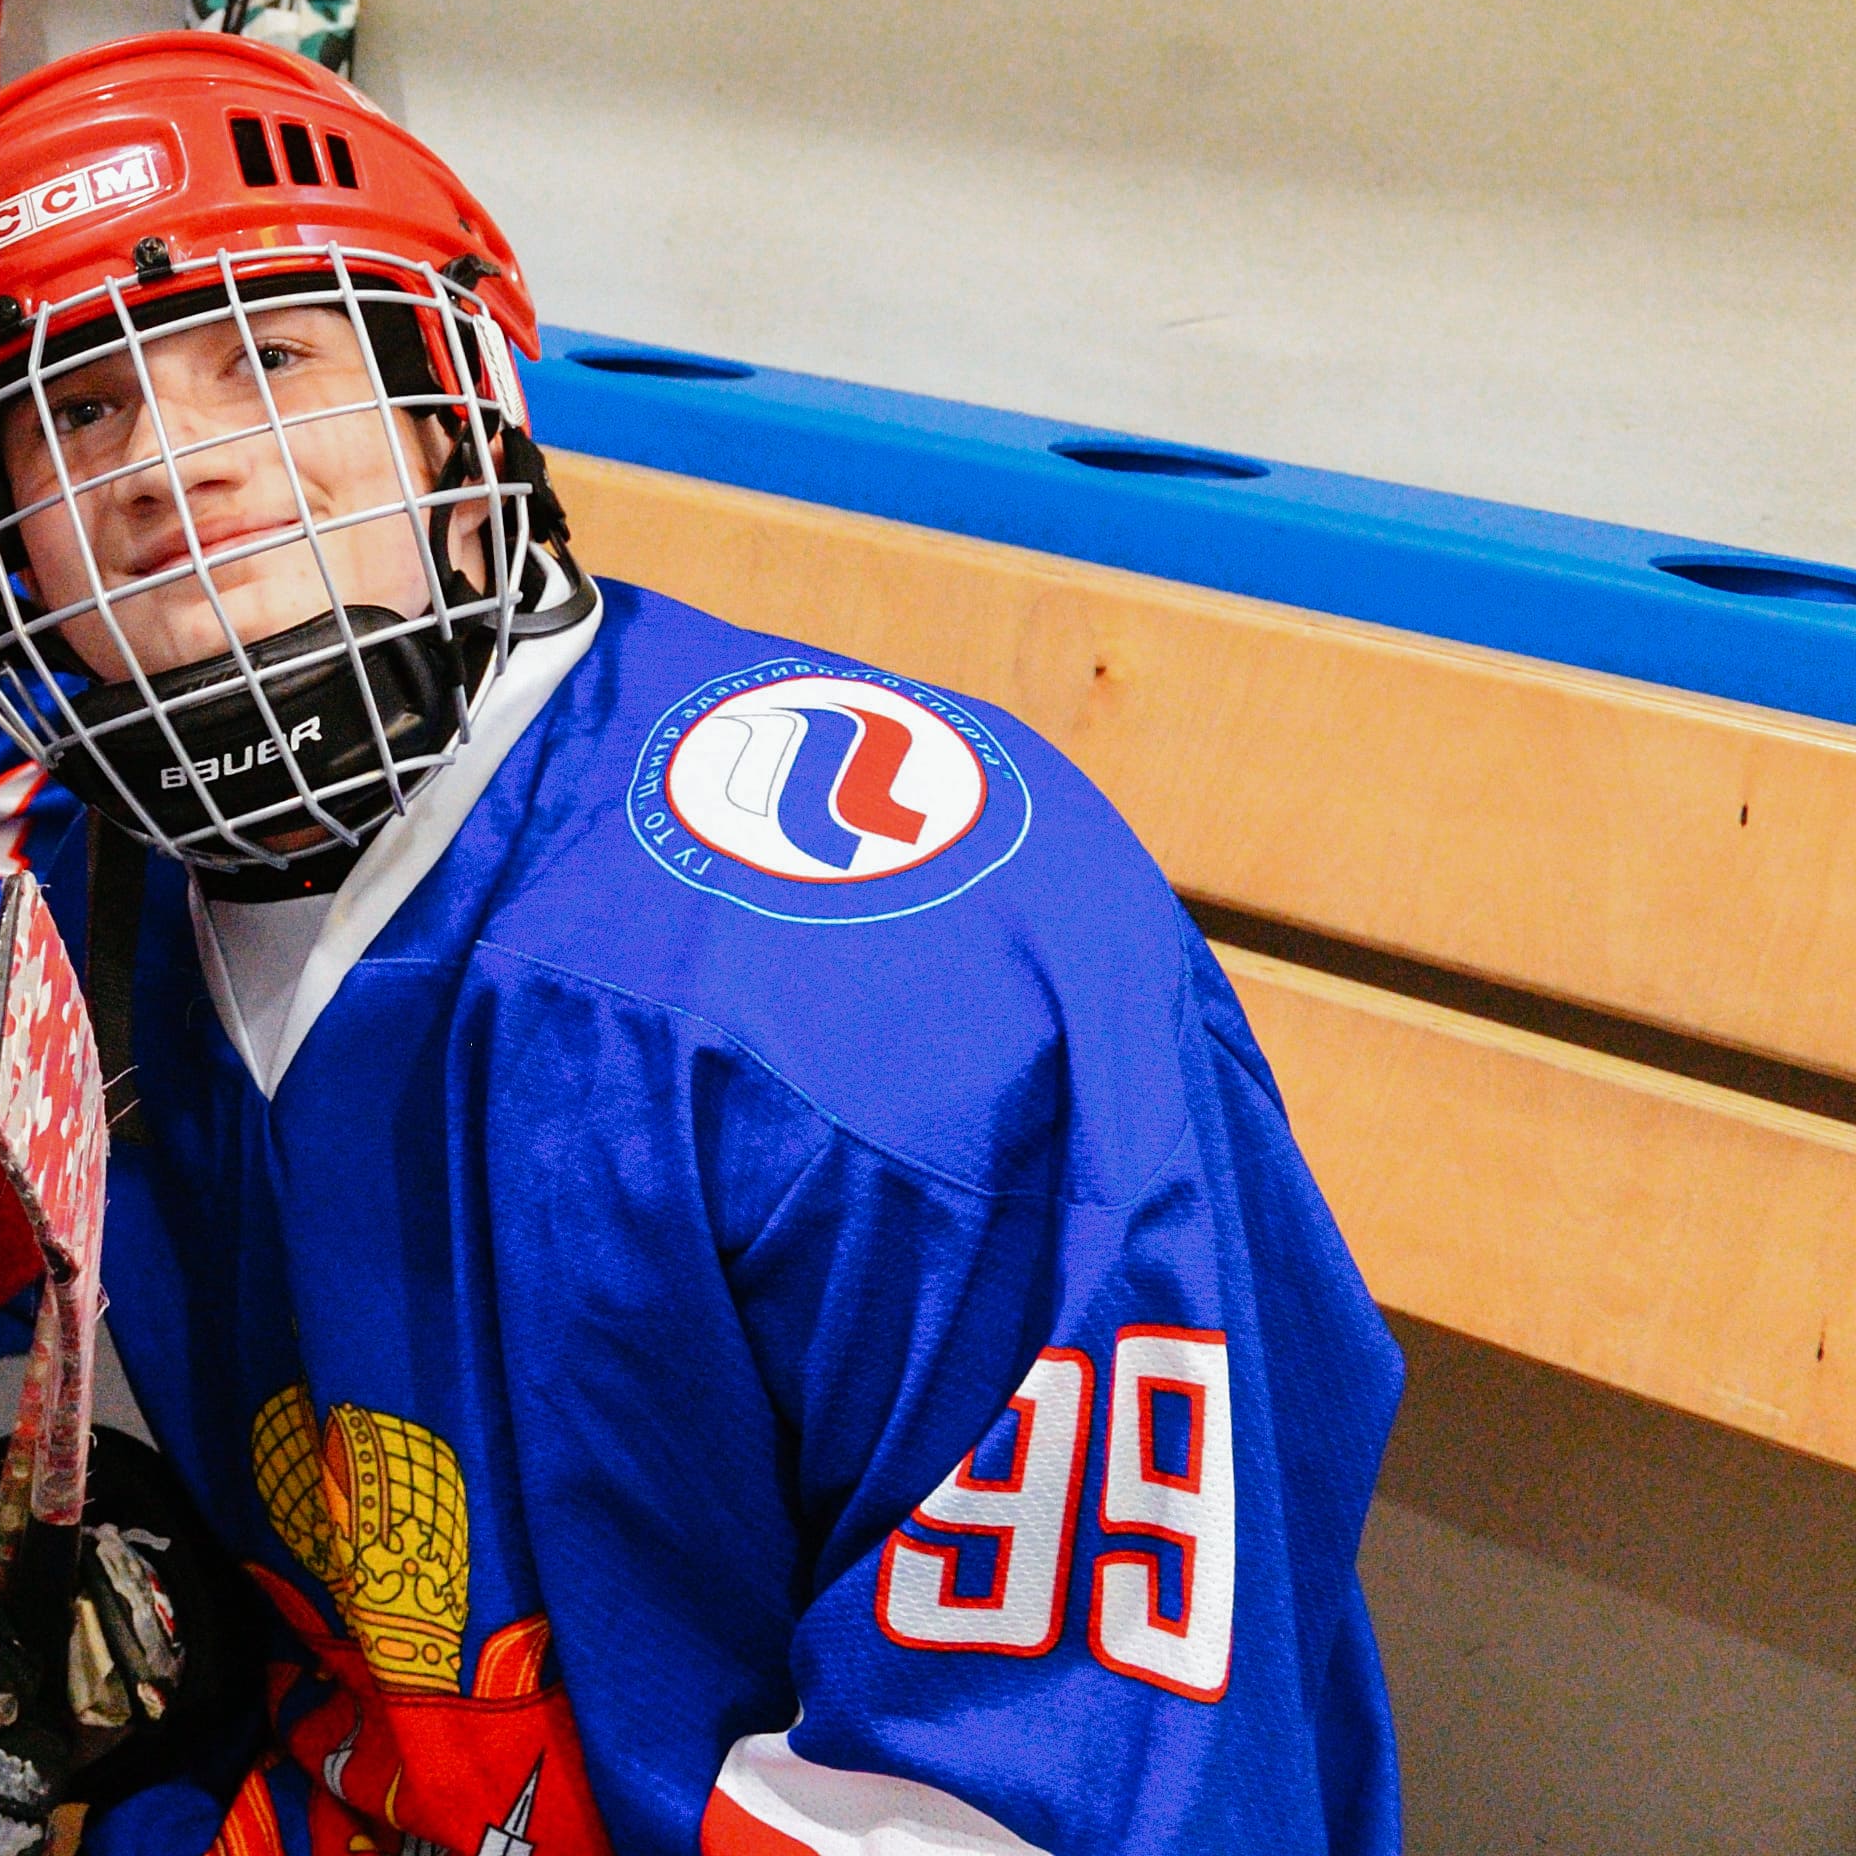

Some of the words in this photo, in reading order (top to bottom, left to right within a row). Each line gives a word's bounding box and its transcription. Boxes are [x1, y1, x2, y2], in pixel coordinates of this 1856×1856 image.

[160, 715, 323, 790] BAUER
[644, 811, 675, 845] ТО
[674, 847, 713, 876] ГУ
[874, 1323, 1237, 1705] 99
